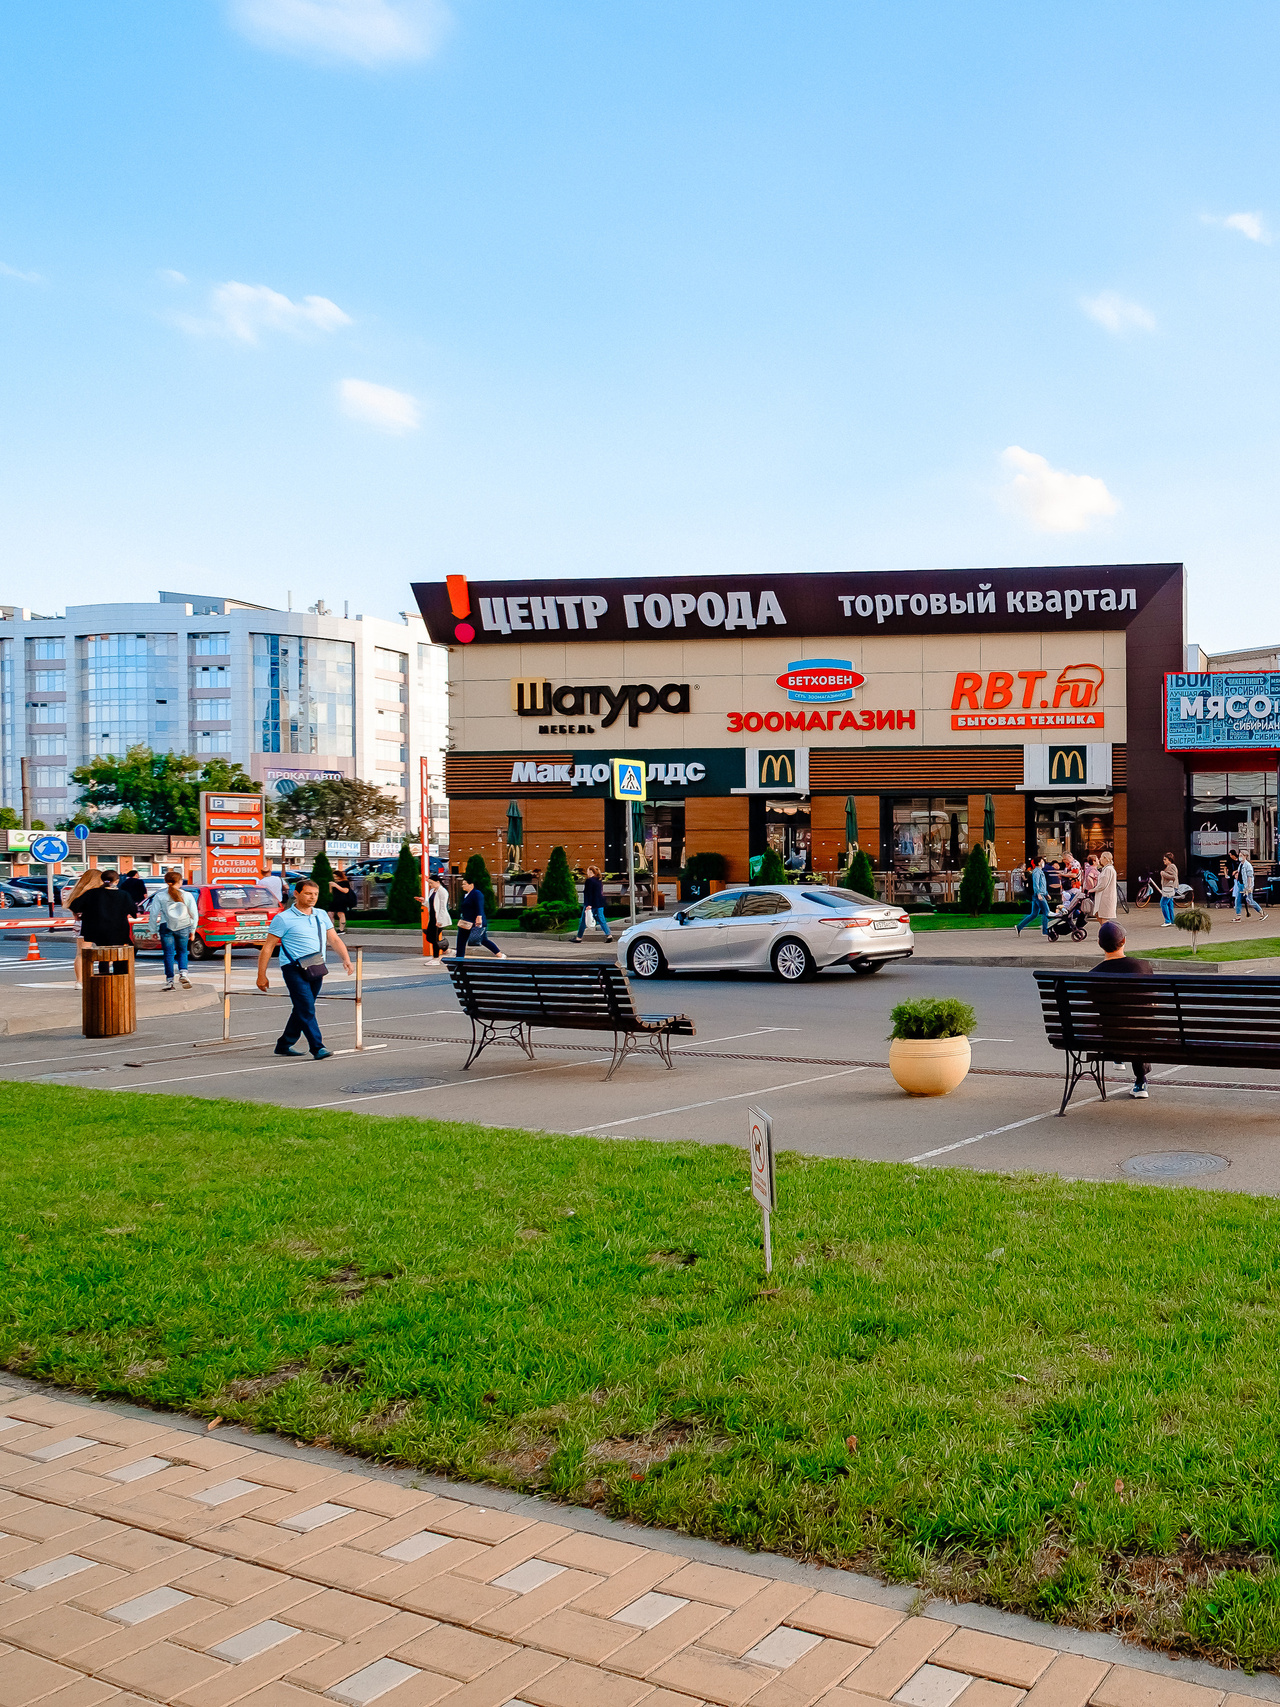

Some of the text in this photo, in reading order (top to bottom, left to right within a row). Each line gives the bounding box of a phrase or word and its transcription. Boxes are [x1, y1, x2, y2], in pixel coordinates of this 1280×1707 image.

[838, 583, 1137, 623] торговый квартал
[478, 596, 608, 634] ЦЕНТР
[623, 591, 787, 630] ГОРОДА
[788, 675, 853, 686] БЕТХОВЕН
[808, 692, 847, 700] ЗООМАГАЗИНОВ
[951, 670, 1094, 710] RBT.ru
[1237, 686, 1269, 696] СИБИРЬ
[511, 677, 691, 728] Шатура
[1180, 695, 1272, 719] МЯСО
[726, 709, 916, 733] ЗООМАГАЗИН
[957, 714, 1096, 728] БЫТОВАЯ ТЕХНИКА
[1233, 722, 1280, 731] СИБИРИАН
[538, 724, 595, 735] МЕБЕЛЬ
[267, 771, 342, 782] ПРОКАТ АВТО
[510, 761, 707, 787] Макдолдс
[327, 841, 359, 849] КЛЮЧИ
